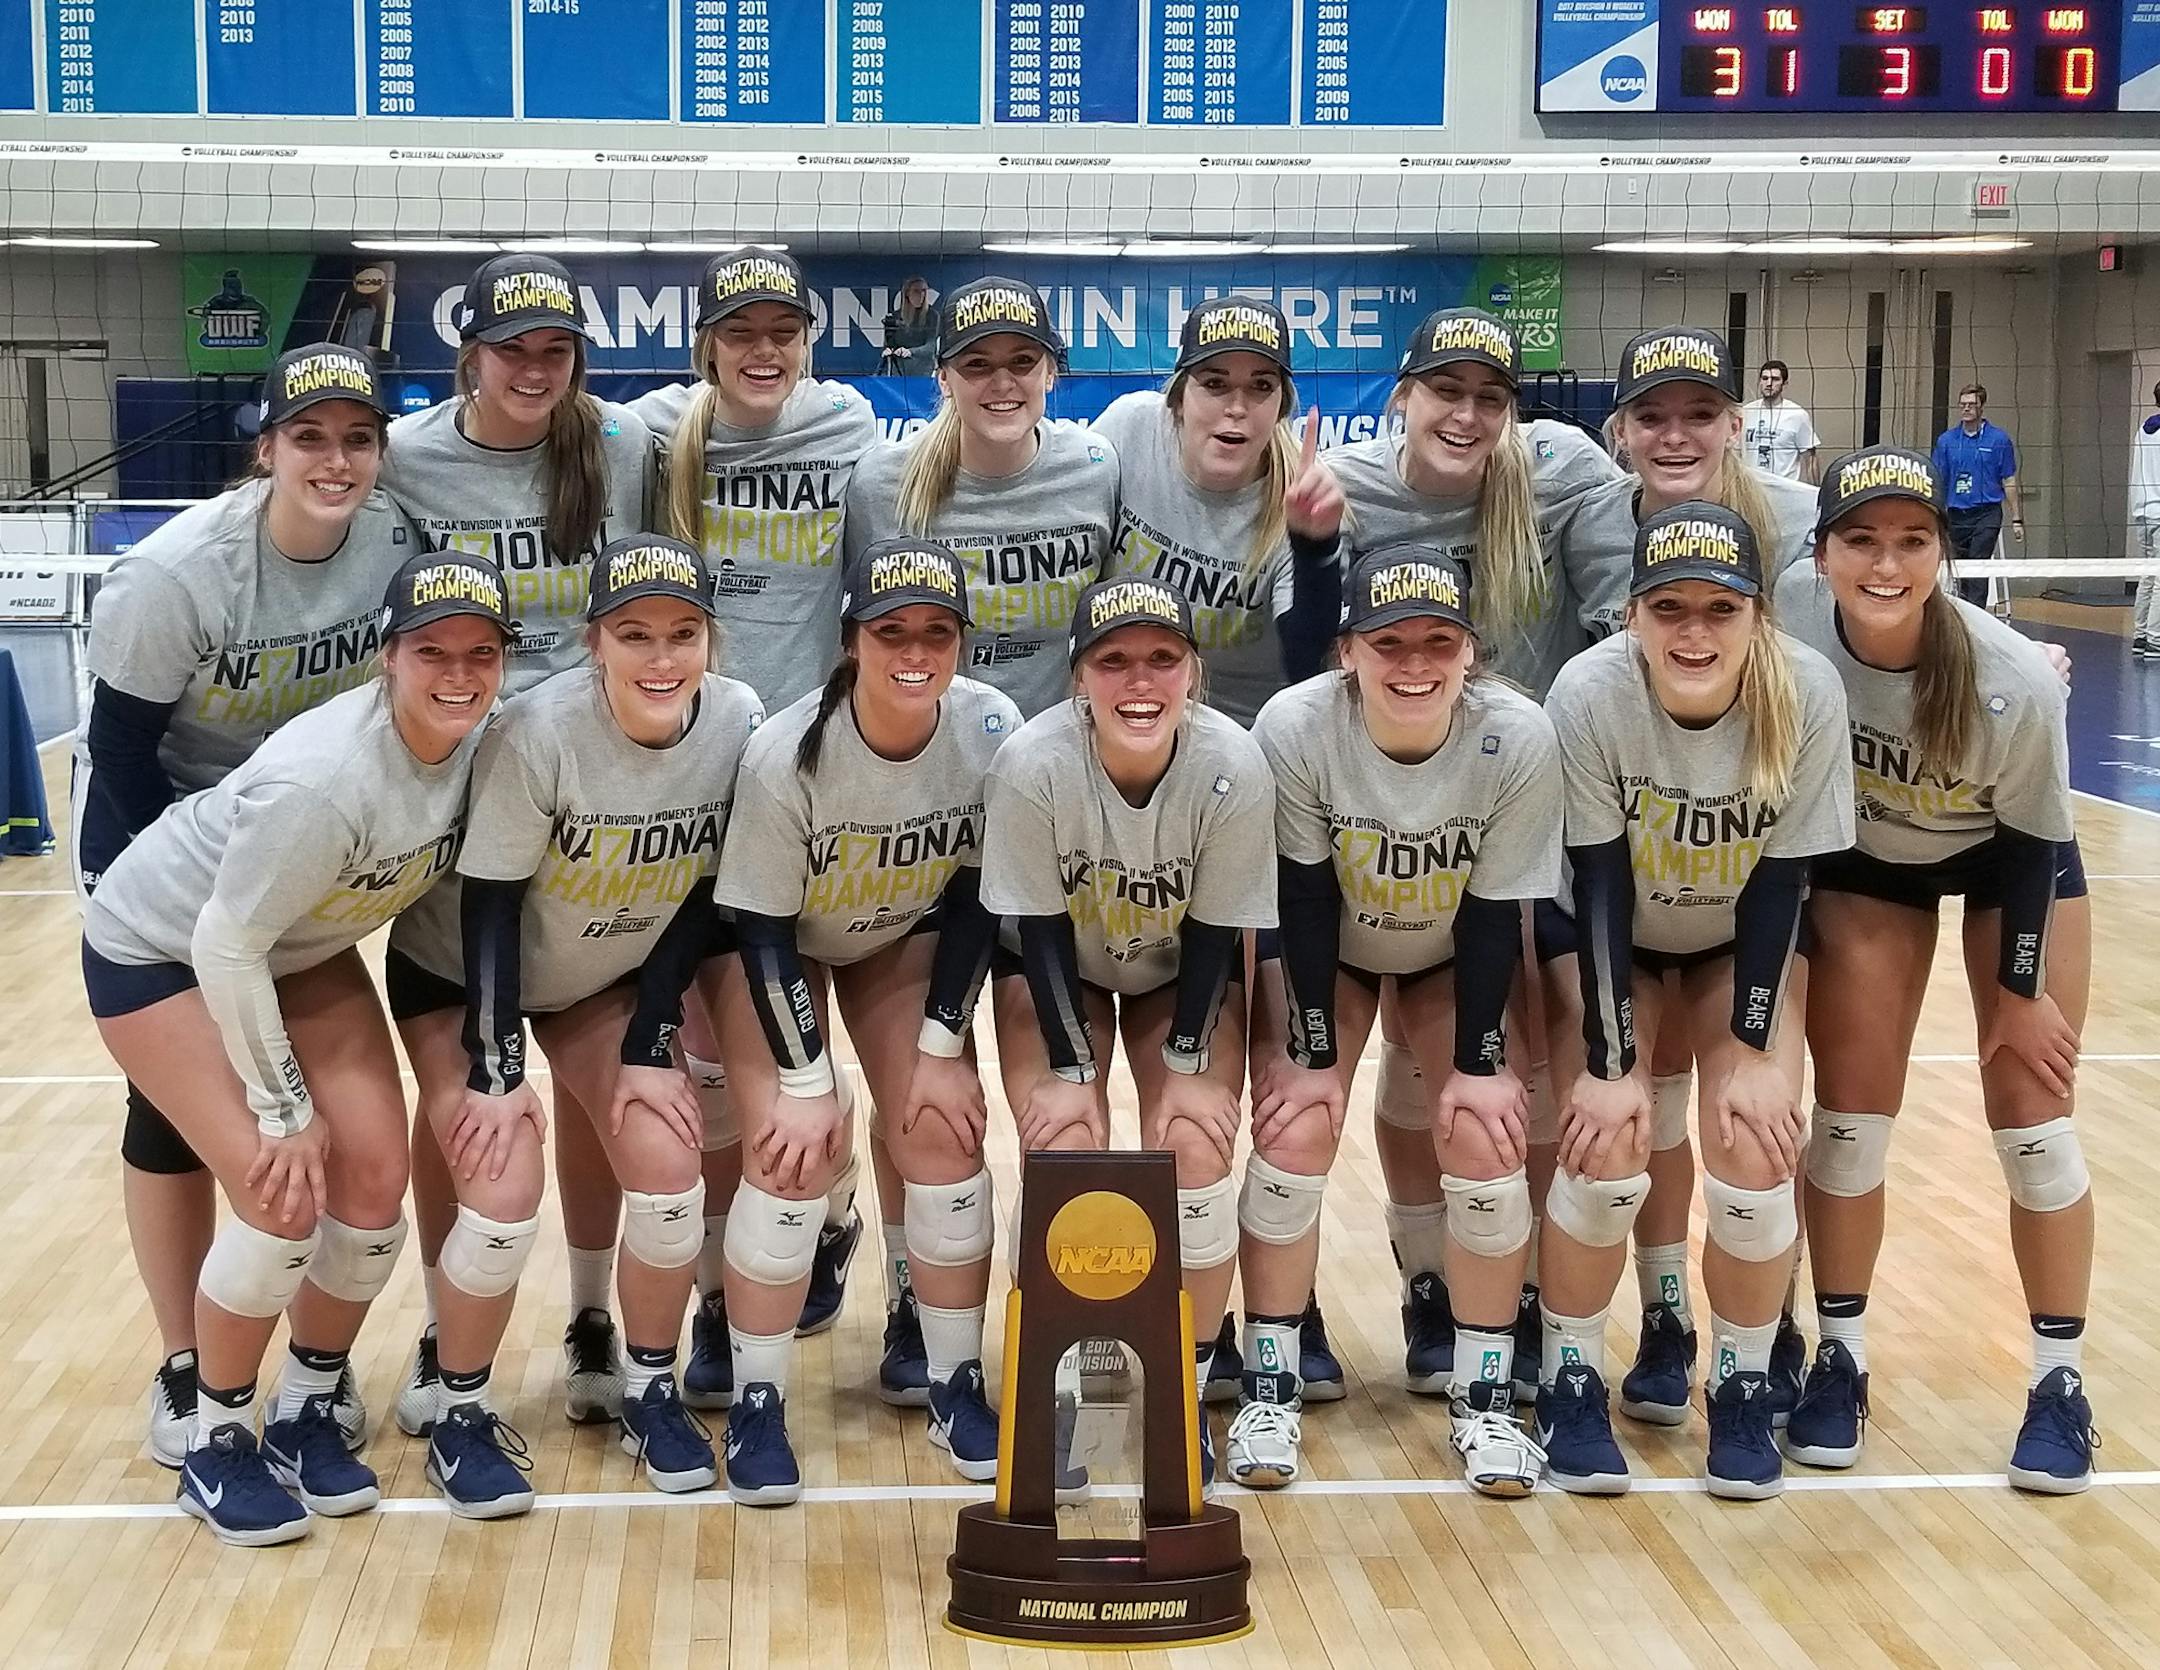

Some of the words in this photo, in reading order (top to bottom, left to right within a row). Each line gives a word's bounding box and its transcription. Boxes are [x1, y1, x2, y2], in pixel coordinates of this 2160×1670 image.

[528, 0, 579, 14] 2014-15
[696, 1, 726, 14] 2000
[739, 1, 766, 15] 2011
[853, 3, 882, 16] 2007
[1011, 4, 1041, 17] 2000
[1051, 5, 1084, 18] 2010
[1165, 5, 1195, 18] 2000
[1206, 6, 1239, 19] 2010
[1319, 6, 1347, 19] 2001
[60, 9, 94, 22] 2010
[220, 11, 254, 24] 2010
[381, 12, 411, 25] 2005
[1694, 9, 1730, 31] WON
[1767, 9, 1797, 31] TOL
[1874, 9, 1905, 31] SET
[1980, 9, 2011, 31] TOL
[2048, 9, 2083, 31] WON
[696, 18, 724, 31] 2001
[738, 19, 768, 32] 2012
[853, 20, 883, 32] 2008
[1011, 21, 1039, 33] 2001
[1051, 20, 1078, 34] 2011
[1165, 22, 1193, 35] 2001
[1206, 21, 1233, 35] 2011
[1318, 23, 1348, 35] 2003
[61, 26, 89, 40] 2011
[222, 29, 253, 42] 2013
[381, 29, 412, 42] 2006
[696, 35, 726, 49] 2002
[738, 37, 769, 50] 2013
[853, 37, 886, 50] 2009
[1011, 38, 1040, 50] 2002
[1051, 38, 1080, 51] 2012
[1165, 39, 1194, 52] 2002
[1205, 39, 1235, 52] 2012
[1318, 40, 1347, 52] 2004
[61, 44, 92, 58] 2012
[381, 47, 411, 60] 2007
[696, 53, 726, 65] 2003
[738, 54, 769, 68] 2014
[853, 54, 883, 67] 2013
[1011, 54, 1040, 67] 2003
[1050, 55, 1080, 69] 2013
[1164, 55, 1194, 68] 2003
[1205, 55, 1235, 68] 2013
[1317, 56, 1347, 69] 2005
[61, 62, 93, 76] 2013
[380, 64, 413, 77] 2008
[696, 70, 726, 82] 2004
[1713, 47, 1740, 96] 3
[1786, 49, 1796, 95] 1
[1884, 48, 1910, 94] 3
[1981, 48, 2010, 94] 0
[2065, 47, 2094, 95] 0
[739, 72, 768, 86] 2015
[853, 72, 883, 85] 2014
[1011, 71, 1040, 84] 2004
[1050, 73, 1080, 87] 2014
[1164, 72, 1194, 85] 2004
[1205, 73, 1235, 86] 2014
[1317, 73, 1346, 86] 2008
[1605, 77, 1647, 91] NCAA
[62, 80, 93, 94] 2014
[380, 81, 414, 94] 2009
[696, 87, 726, 99] 2005
[1010, 88, 1040, 100] 2005
[739, 90, 768, 103] 2016
[852, 90, 882, 103] 2015
[1050, 91, 1079, 104] 2015
[1164, 89, 1193, 102] 2005
[1205, 90, 1234, 104] 2015
[1316, 91, 1349, 103] 2009
[63, 98, 93, 113] 2015
[380, 98, 414, 112] 2010
[696, 104, 726, 116] 2006
[1010, 105, 1040, 117] 2006
[853, 108, 882, 121] 2016
[1050, 108, 1079, 123] 2016
[1163, 106, 1193, 119] 2006
[1205, 109, 1234, 122] 2016
[1316, 107, 1348, 120] 2010
[1980, 186, 2008, 206] EXIT
[716, 273, 797, 301] CHAMPIONS
[493, 288, 574, 316] CHAMPIONS
[955, 303, 1037, 332] CHAMPIONS
[1168, 287, 1382, 348] HRE
[1503, 309, 1543, 320] MAKE
[1545, 308, 1558, 319] IT
[207, 315, 260, 337] UWF
[1199, 322, 1280, 350] CHAMPIONS
[1432, 331, 1513, 368] CHAMPIONS
[1632, 350, 1719, 380] CHAMPIONS
[285, 370, 373, 399] CHAMPIONS
[739, 463, 783, 475] WOMEN'S
[787, 460, 840, 472] VOLLEYBALL
[1840, 468, 1932, 499] CHAMPIONS
[461, 518, 502, 531] DIVISION
[954, 537, 996, 548] DIVISION
[1007, 531, 1048, 543] WOMEN'S
[1051, 523, 1097, 538] VOLLEYBALL
[1141, 525, 1173, 550] DIVISION
[1646, 538, 1739, 567] CHAMPIONS
[609, 560, 697, 593] CHAMPIONS
[720, 577, 768, 589] VOLLEYBALL
[871, 567, 957, 598] CHAMPIONS
[414, 579, 502, 615] CHAMPIONS
[1370, 579, 1460, 610] CHAMPIONS
[9, 598, 56, 608] #NCAAD2
[1091, 597, 1179, 629] CHAMPIONS
[270, 632, 309, 649] DIVISION
[1859, 722, 1903, 746] WOMEN'S
[604, 814, 645, 826] DIVISION
[654, 807, 695, 823] WOMEN'S
[850, 821, 893, 834] DIVISION
[903, 810, 944, 829] WOMEN'S
[376, 856, 396, 871] 2017
[2013, 933, 2038, 975] BEARS
[790, 977, 816, 1034] GOLDEN
[1744, 986, 1771, 1030] BEARS
[1057, 1244, 1152, 1275] NCAA
[1085, 1340, 1115, 1354] 2017
[1063, 1355, 1125, 1371] DIVISION
[1019, 1598, 1097, 1621] NATIONAL
[1100, 1599, 1188, 1621] CHAMPION
